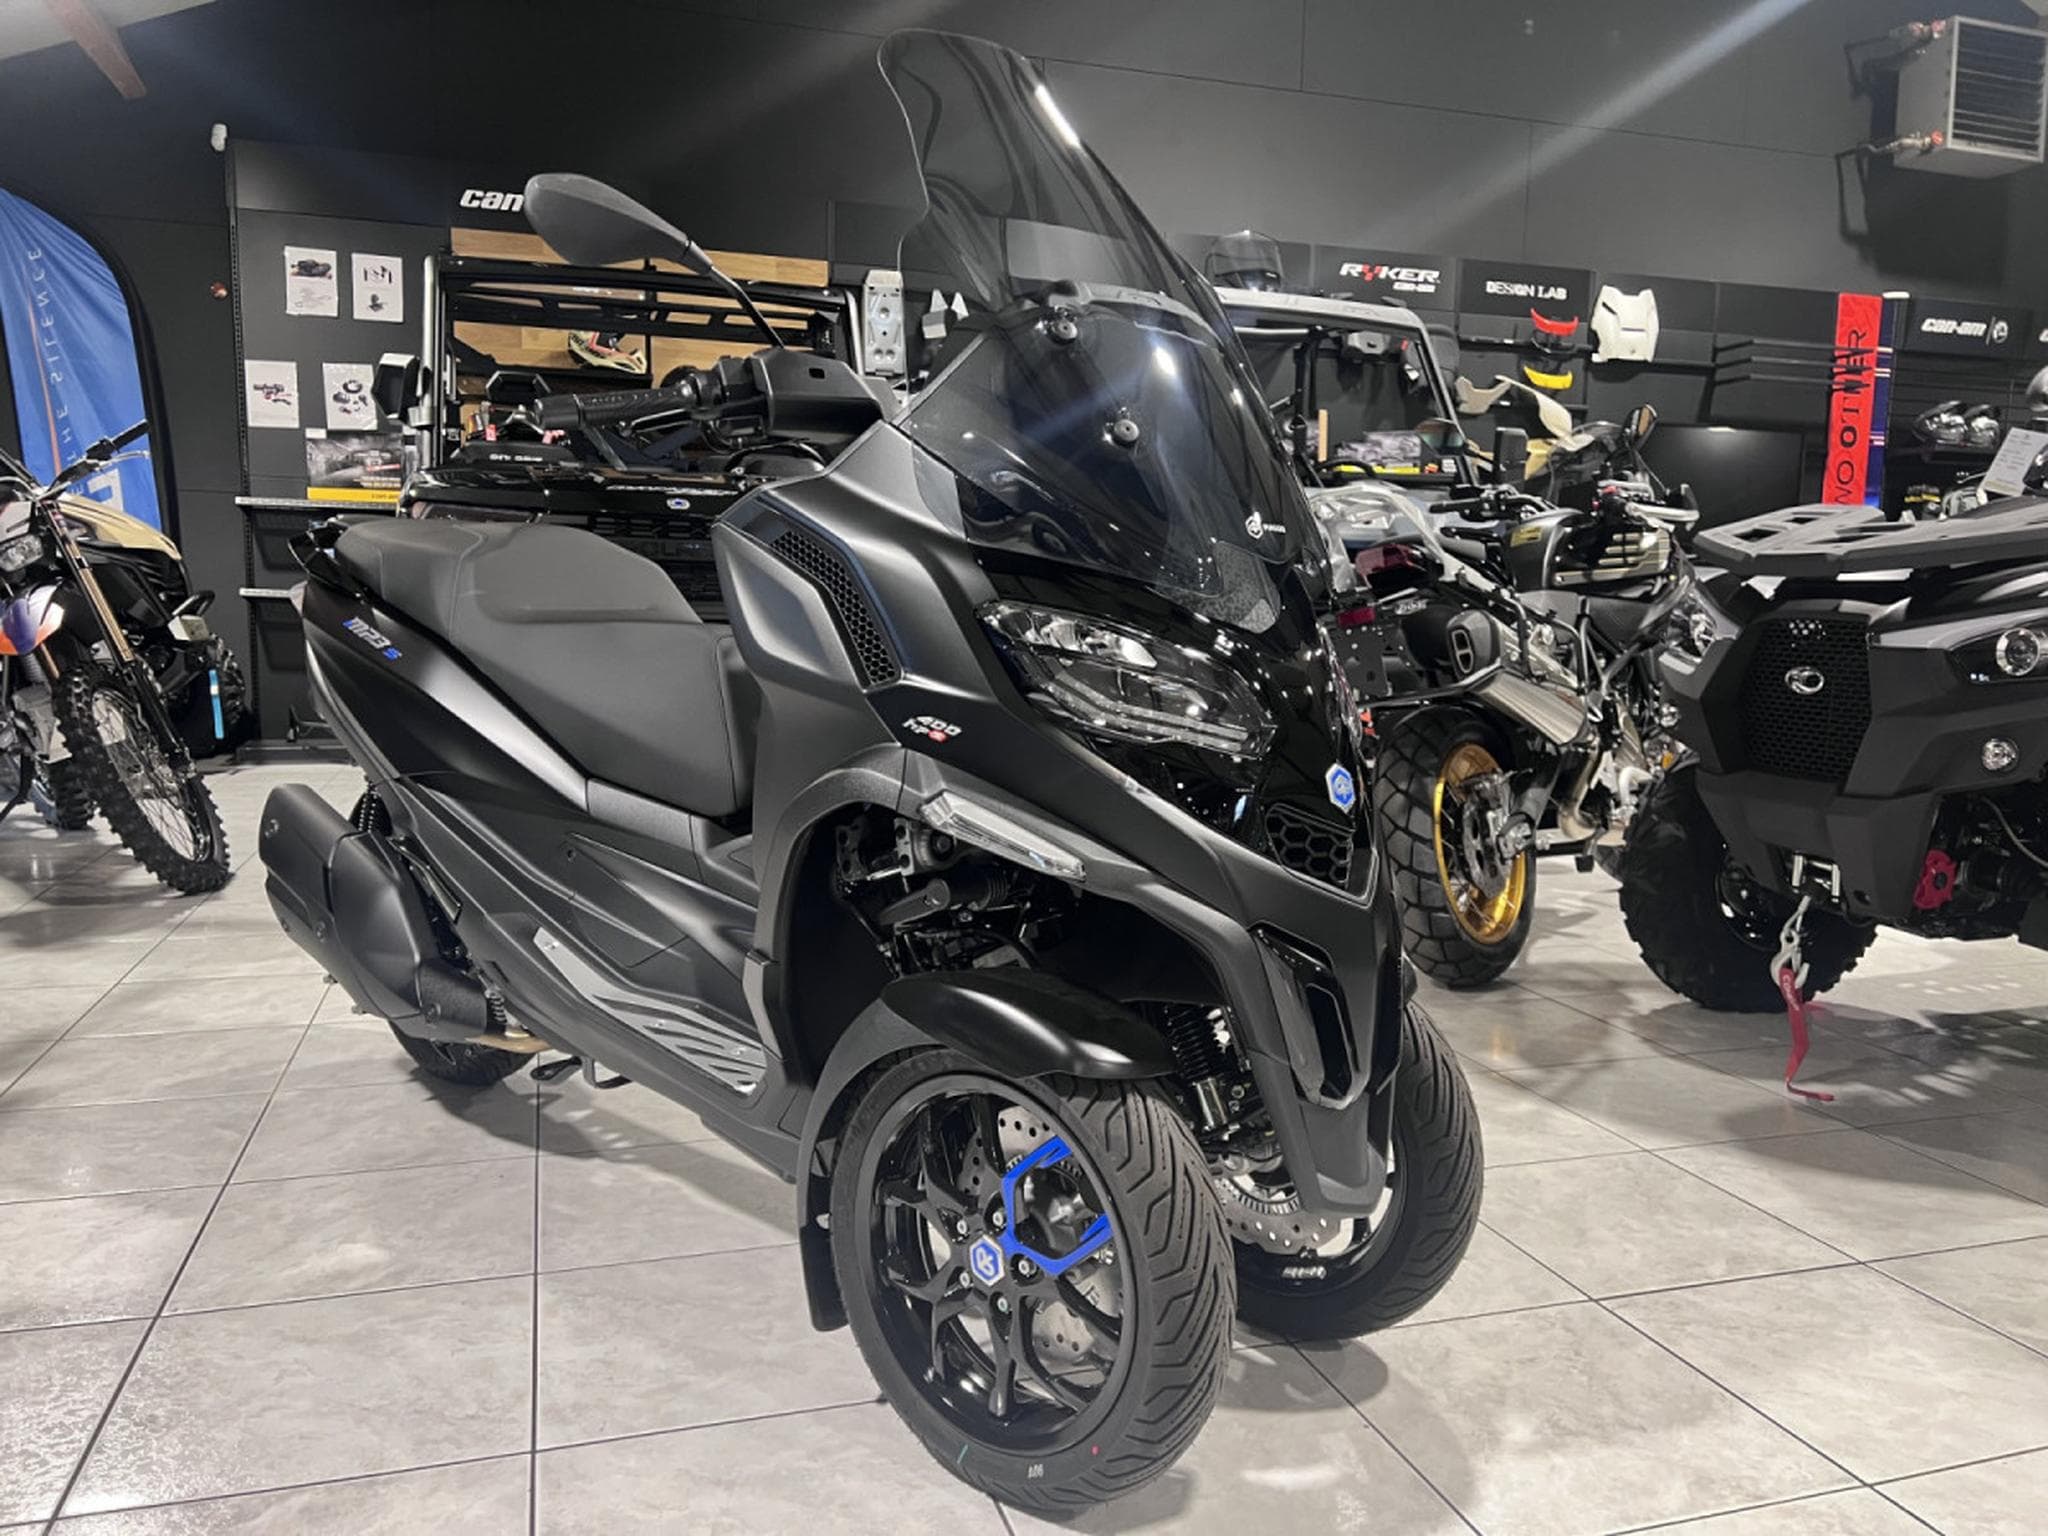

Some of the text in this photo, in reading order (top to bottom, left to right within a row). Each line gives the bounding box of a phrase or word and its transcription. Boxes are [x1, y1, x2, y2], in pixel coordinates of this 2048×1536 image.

[1339, 262, 1440, 283] RYKER
[1485, 281, 1568, 301] DESIGN LAB
